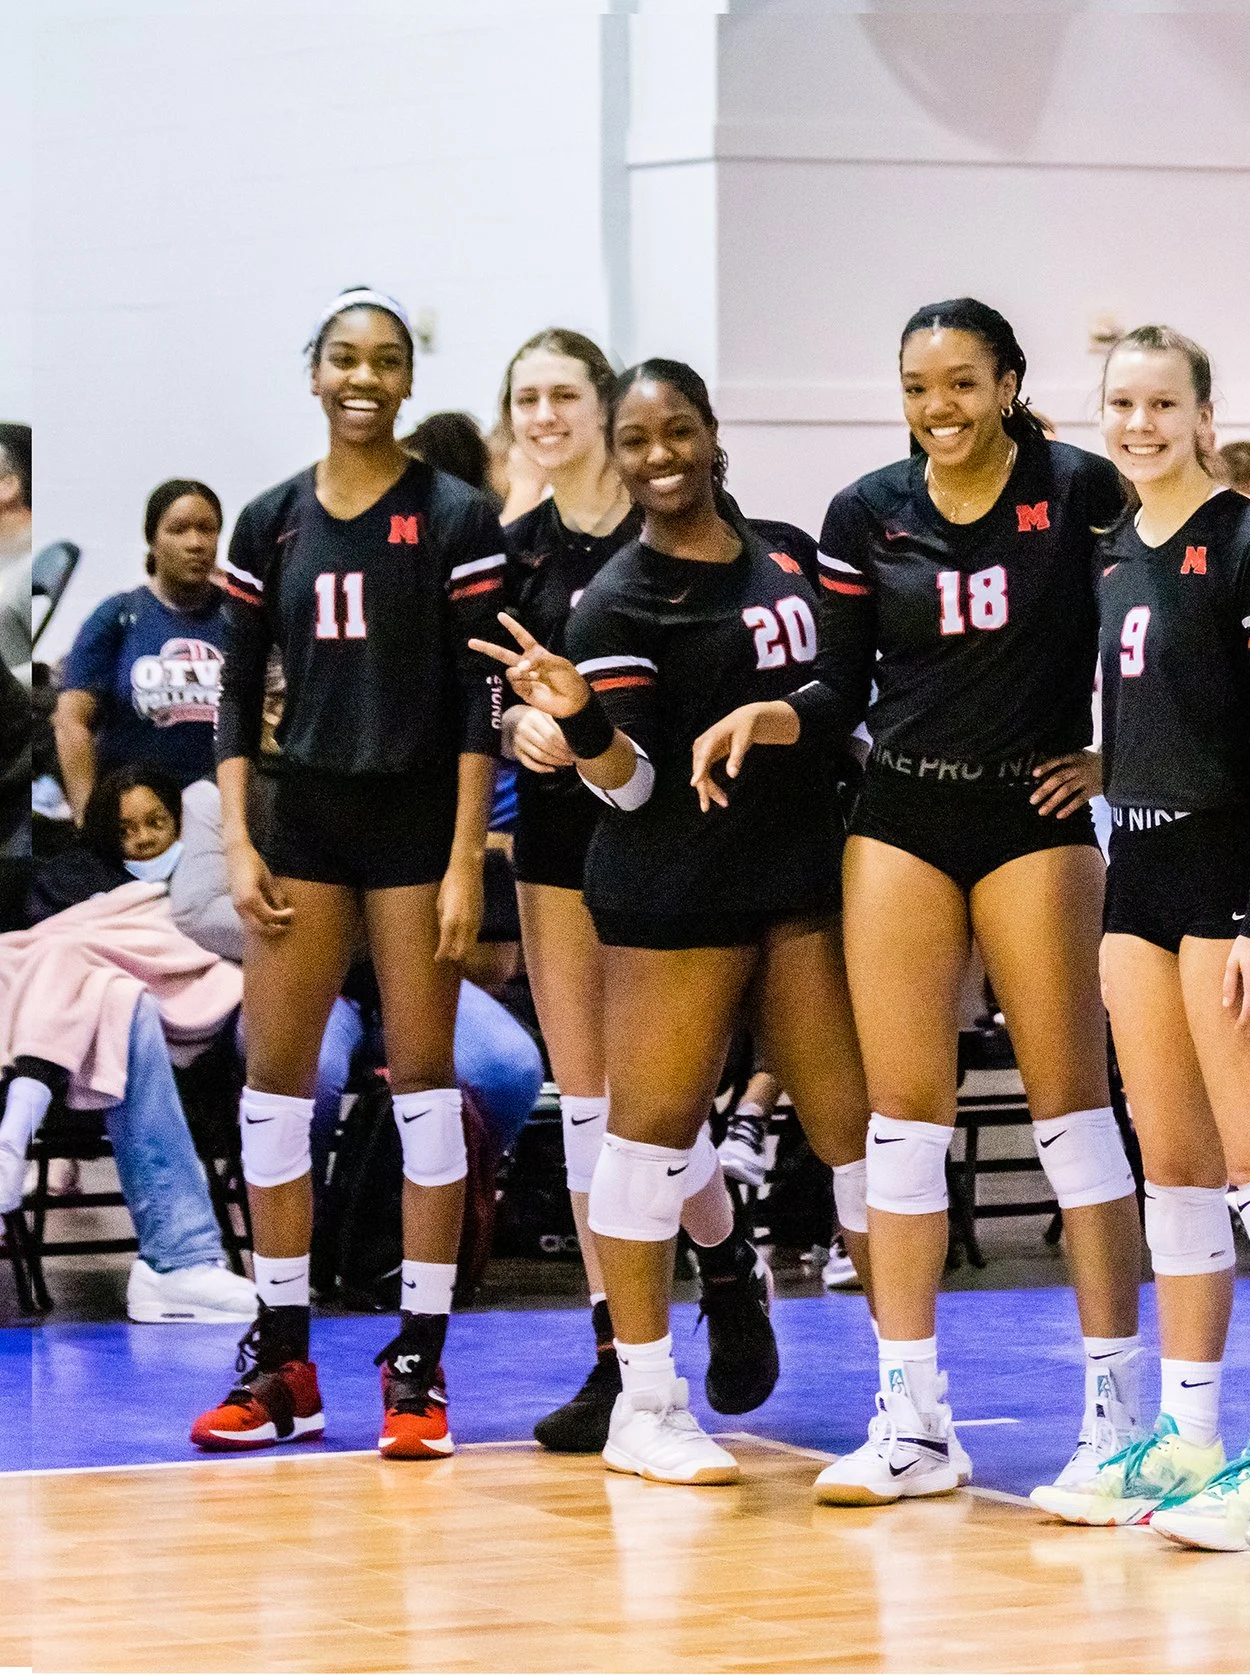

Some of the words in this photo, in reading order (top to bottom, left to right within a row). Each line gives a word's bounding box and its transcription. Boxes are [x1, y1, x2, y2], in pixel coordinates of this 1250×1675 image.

[1015, 501, 1051, 532] M
[314, 572, 367, 639] 11
[741, 595, 818, 670] 20
[936, 564, 1009, 636] 18
[1120, 605, 1152, 679] 9
